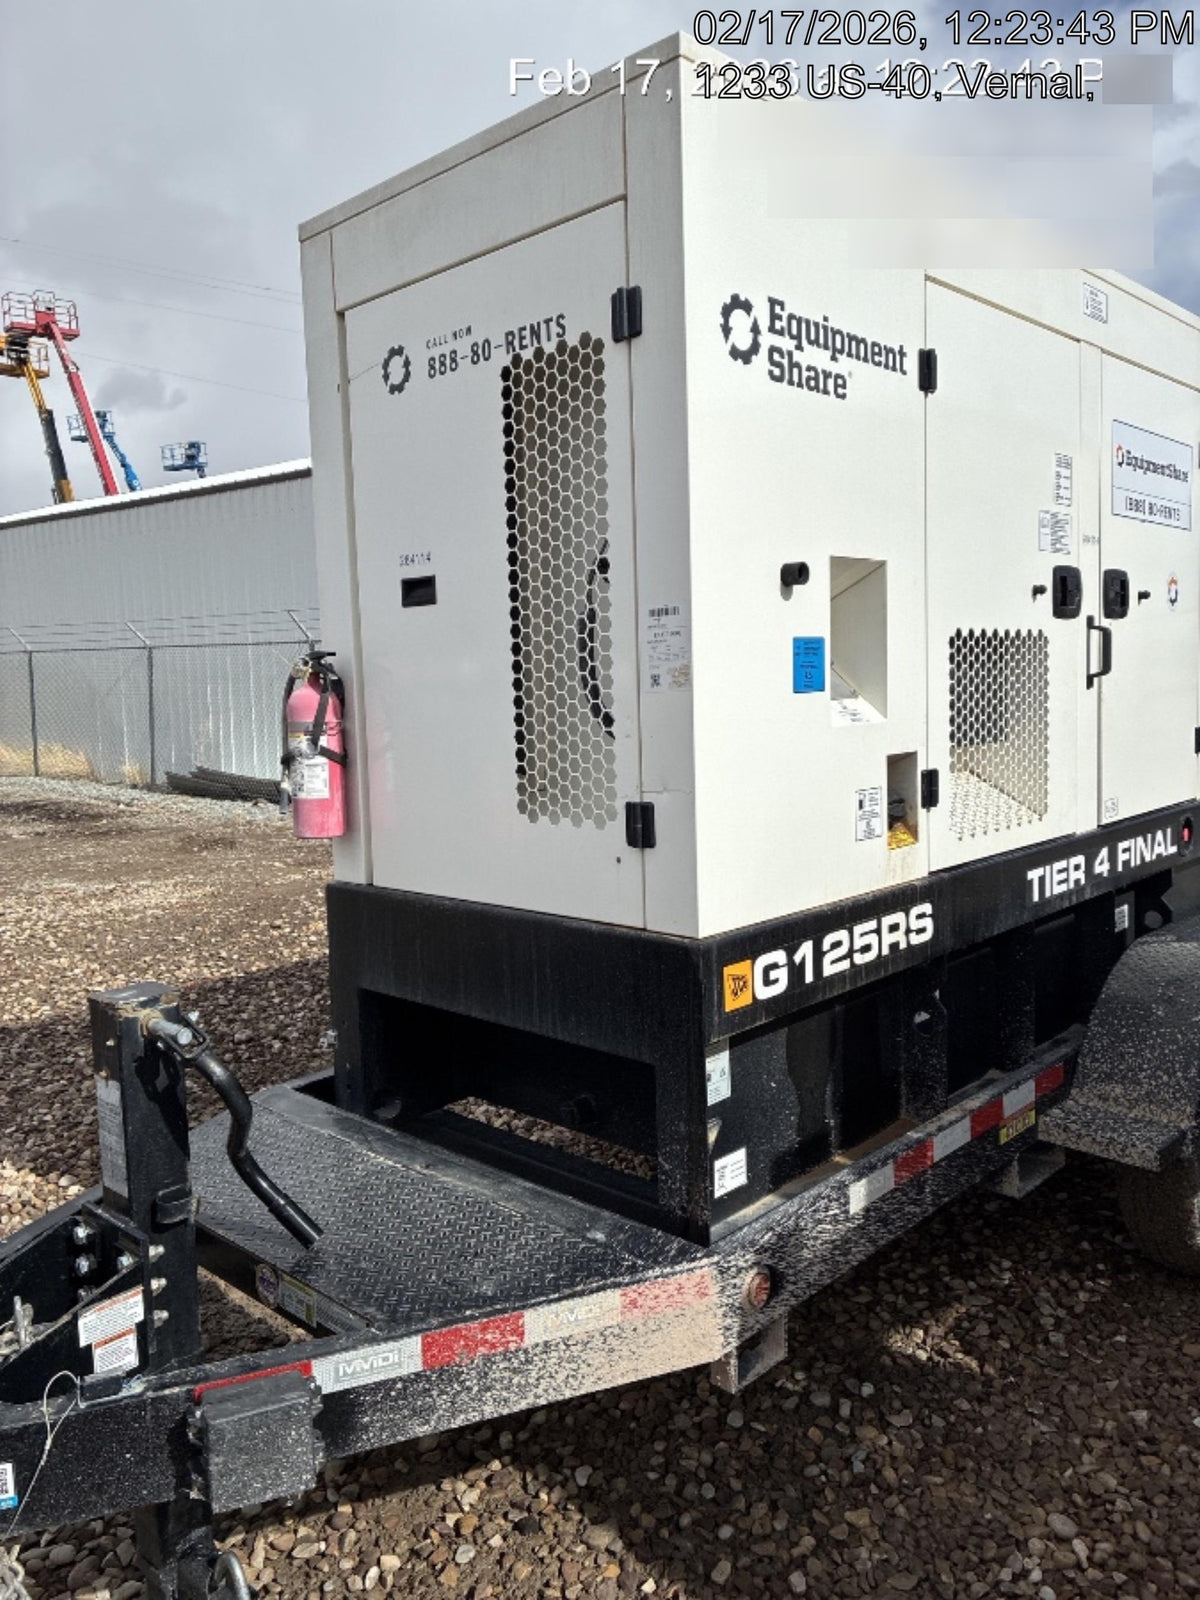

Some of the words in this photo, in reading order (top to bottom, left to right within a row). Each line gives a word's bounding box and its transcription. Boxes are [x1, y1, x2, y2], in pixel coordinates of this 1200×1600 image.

[426, 336, 449, 350] CALL
[427, 313, 566, 379] 888-80-RENTS
[767, 296, 907, 376] Equipment
[1027, 855, 1085, 902] TIER
[1094, 846, 1110, 877] 4
[1117, 827, 1178, 872] FINAL
[754, 902, 934, 1000] G125RS
